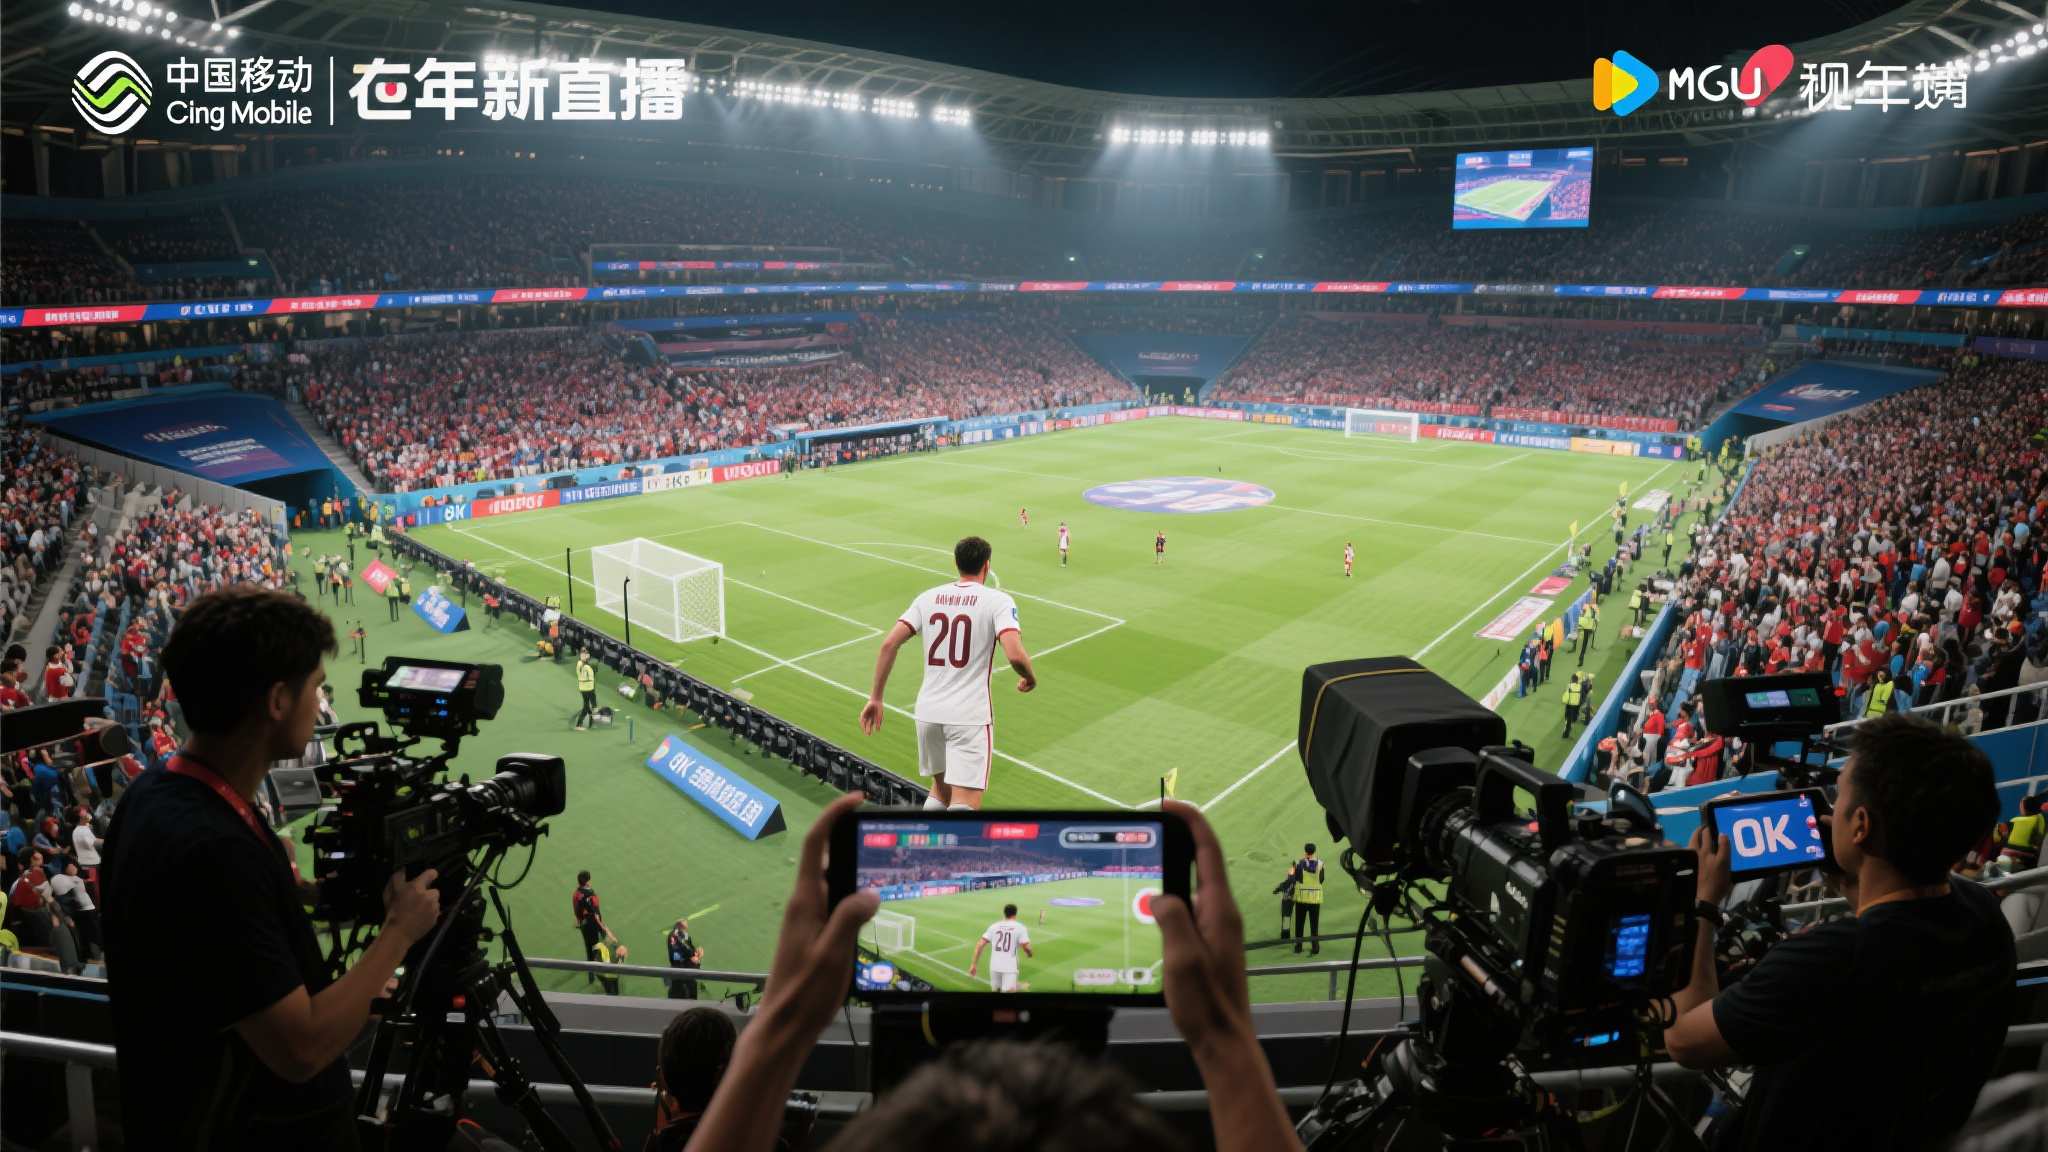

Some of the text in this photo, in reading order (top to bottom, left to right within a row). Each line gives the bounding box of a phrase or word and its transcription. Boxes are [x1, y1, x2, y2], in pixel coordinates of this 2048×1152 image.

[928, 612, 972, 668] 20
[1732, 814, 1797, 857] OK
[995, 930, 1011, 952] 20
